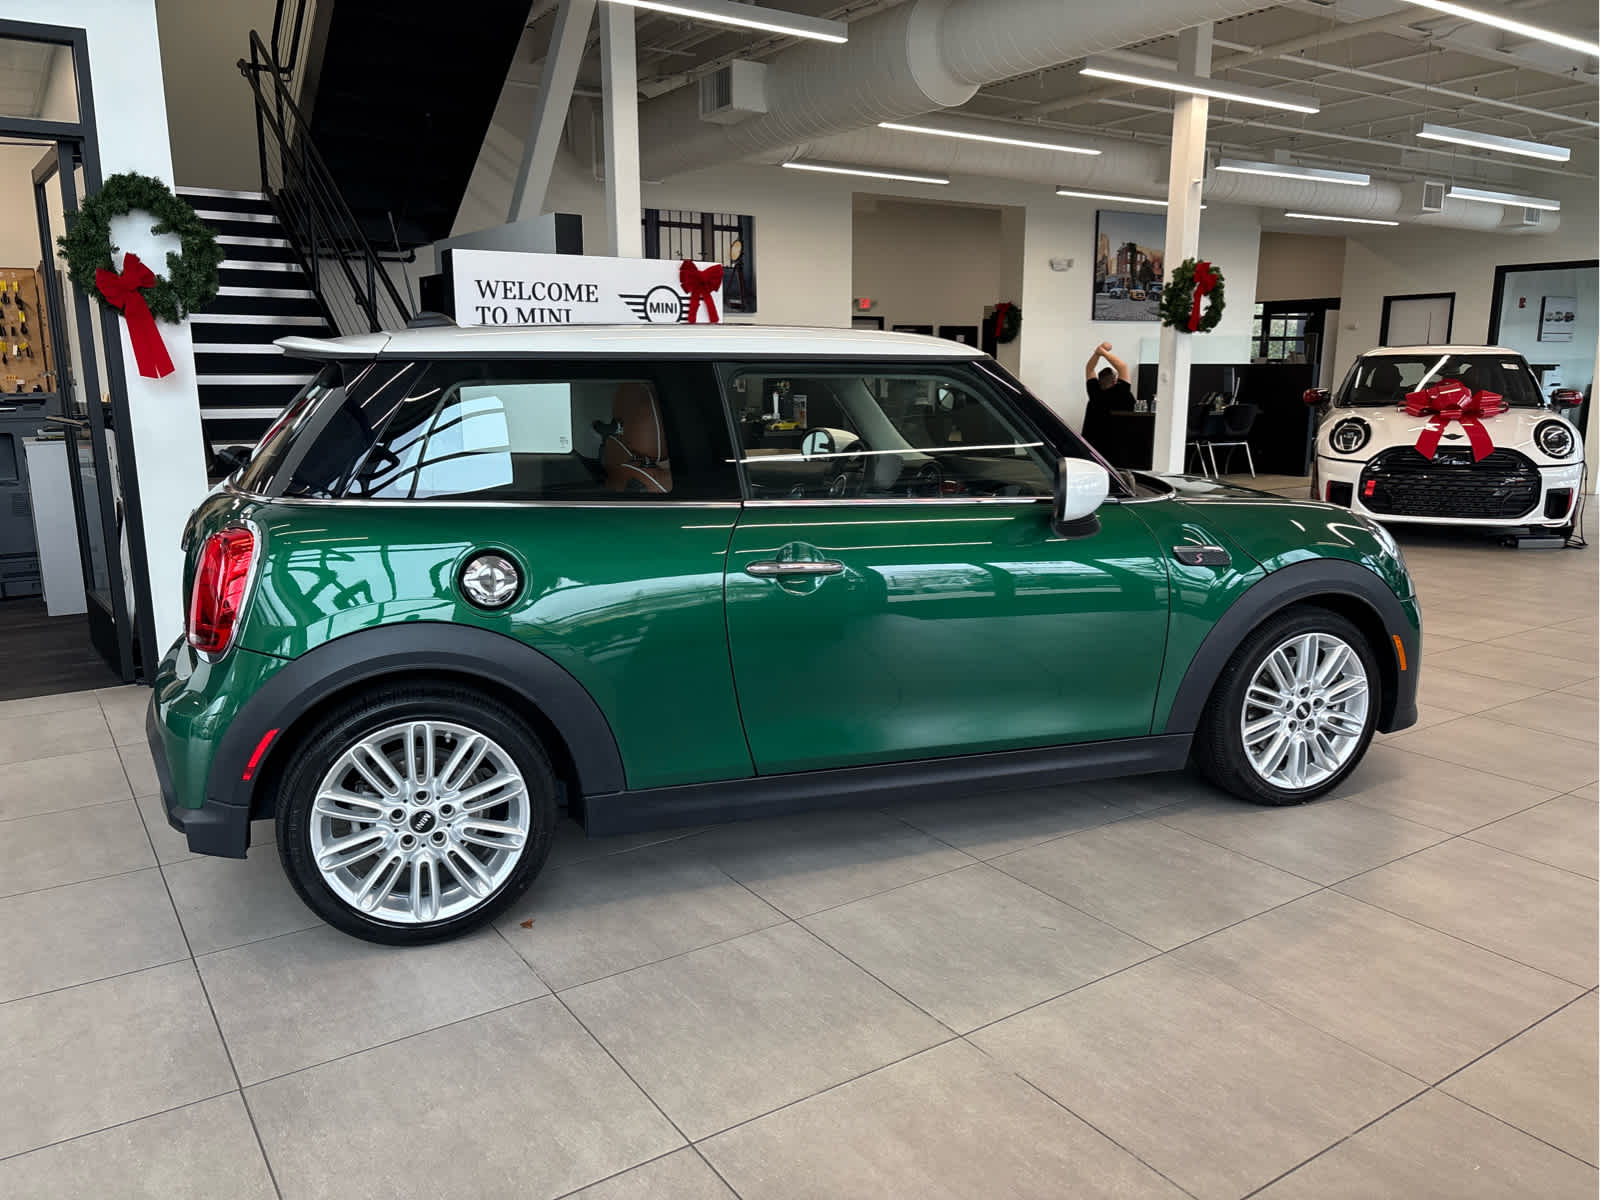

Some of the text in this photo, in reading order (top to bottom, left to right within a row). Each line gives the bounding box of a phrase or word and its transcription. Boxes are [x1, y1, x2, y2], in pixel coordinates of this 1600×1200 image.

[474, 280, 599, 303] WELCOME
[475, 306, 572, 325] TO MINI
[649, 300, 679, 315] MINI
[1194, 552, 1203, 564] S
[415, 813, 432, 831] MINI
